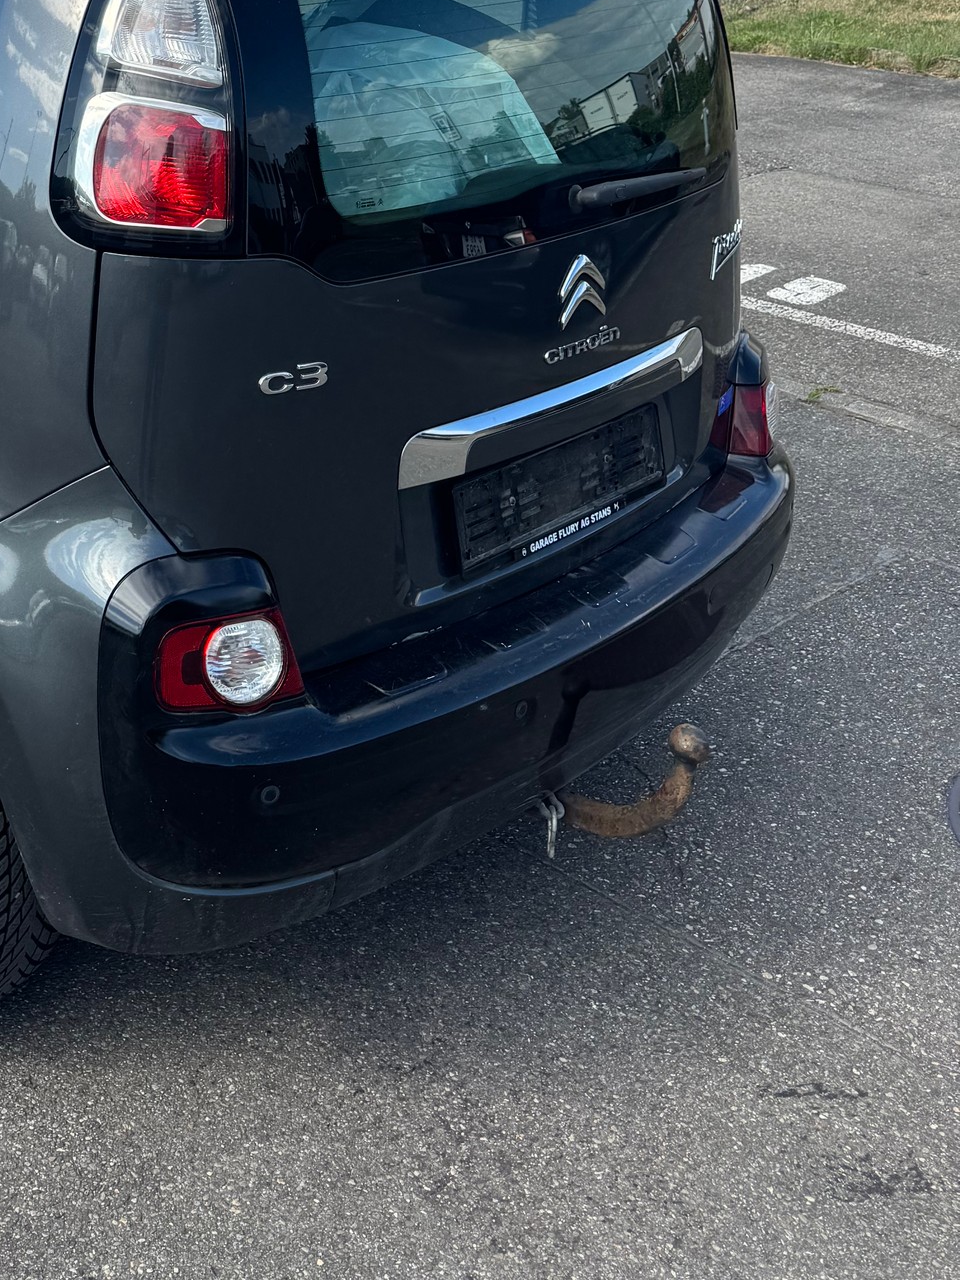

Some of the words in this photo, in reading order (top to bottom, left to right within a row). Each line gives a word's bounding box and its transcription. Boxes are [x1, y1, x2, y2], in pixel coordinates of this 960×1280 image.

[544, 325, 621, 365] CITROËN
[258, 361, 328, 395] C3
[529, 532, 559, 553] GARAGE
[558, 520, 581, 540] FLURY
[580, 516, 590, 529] AG
[590, 506, 612, 524] STANS
